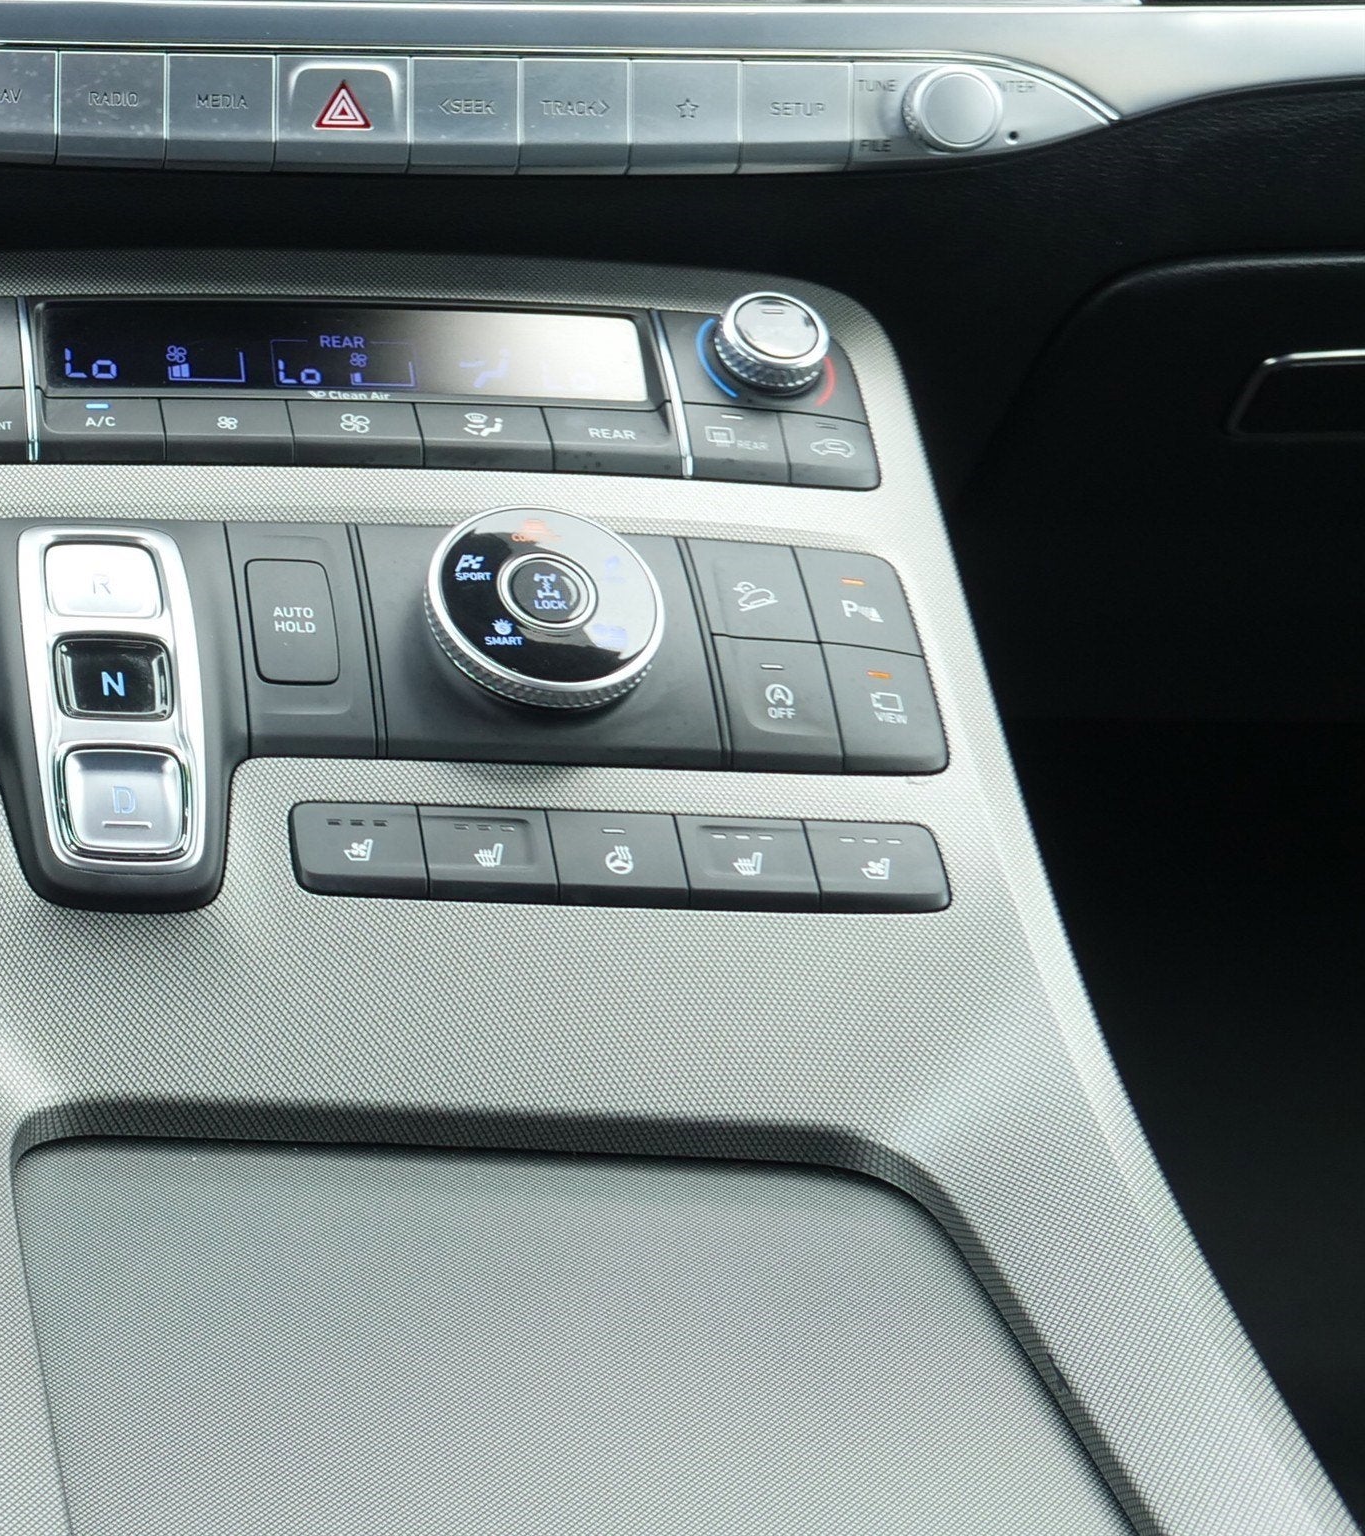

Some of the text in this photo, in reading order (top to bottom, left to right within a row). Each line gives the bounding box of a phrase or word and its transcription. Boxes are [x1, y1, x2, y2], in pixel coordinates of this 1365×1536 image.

[856, 78, 899, 93] TUNE
[88, 90, 139, 109] RADIO
[196, 93, 249, 110] MEDIA
[770, 101, 826, 118] SETUP
[859, 138, 892, 153] FILE
[319, 335, 365, 349] REAR
[329, 390, 391, 401] Clean Air
[85, 415, 116, 428] A/C
[588, 426, 637, 441] REAR
[736, 440, 768, 451] REAR
[455, 571, 492, 582] SPORT
[92, 573, 111, 595] R
[534, 599, 568, 610] LOCK
[273, 606, 314, 619] AUTO
[274, 620, 316, 634] HOLD
[484, 636, 523, 646] SMART
[101, 671, 125, 696] N
[767, 707, 796, 719] OFF
[874, 711, 908, 725] VIEW
[111, 786, 137, 814] D
